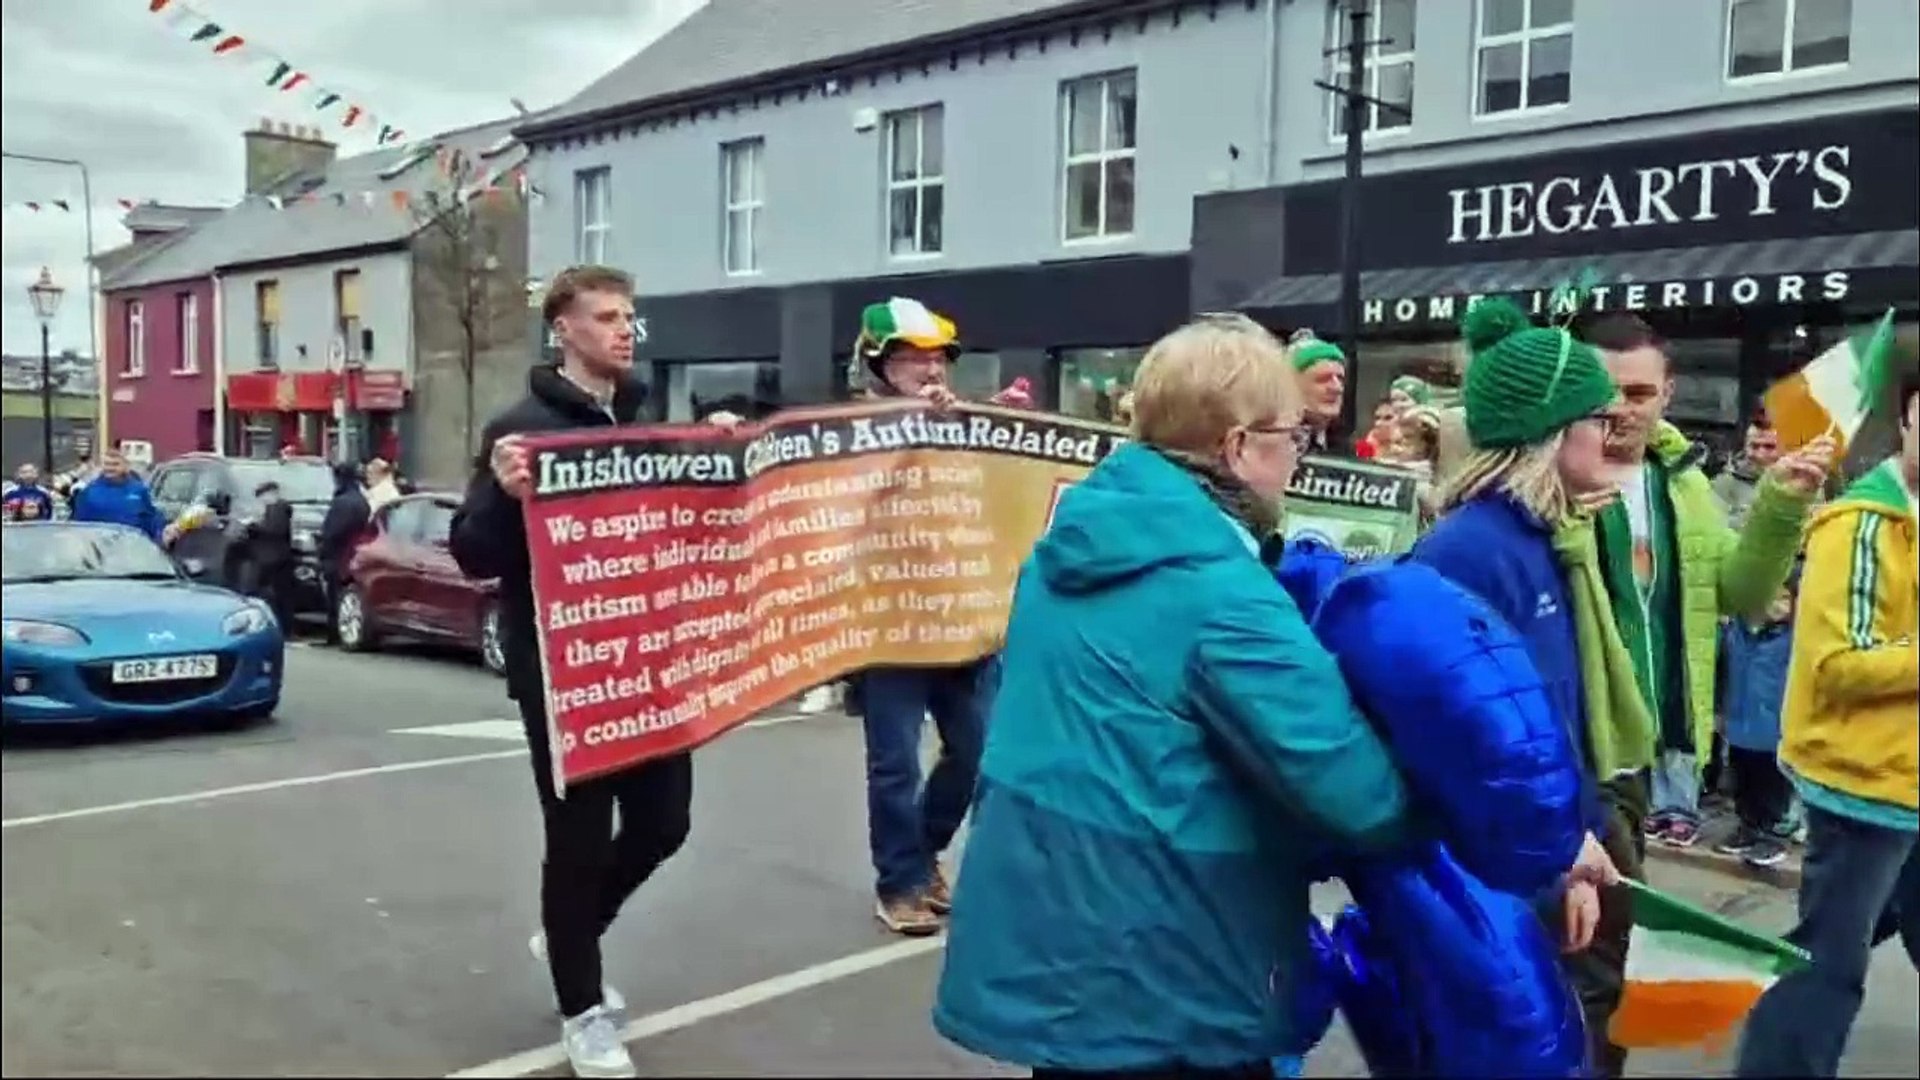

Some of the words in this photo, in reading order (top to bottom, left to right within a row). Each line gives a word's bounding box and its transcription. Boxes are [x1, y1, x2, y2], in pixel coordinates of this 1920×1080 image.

[1447, 145, 1851, 243] HEGARTY'S
[1532, 271, 1851, 314] INTERIORS
[535, 445, 736, 494] Inishowen
[968, 415, 1100, 463] Related
[545, 516, 587, 546] We
[672, 502, 696, 528] to
[562, 551, 648, 585] where
[566, 637, 629, 668] they
[552, 667, 653, 714] treated
